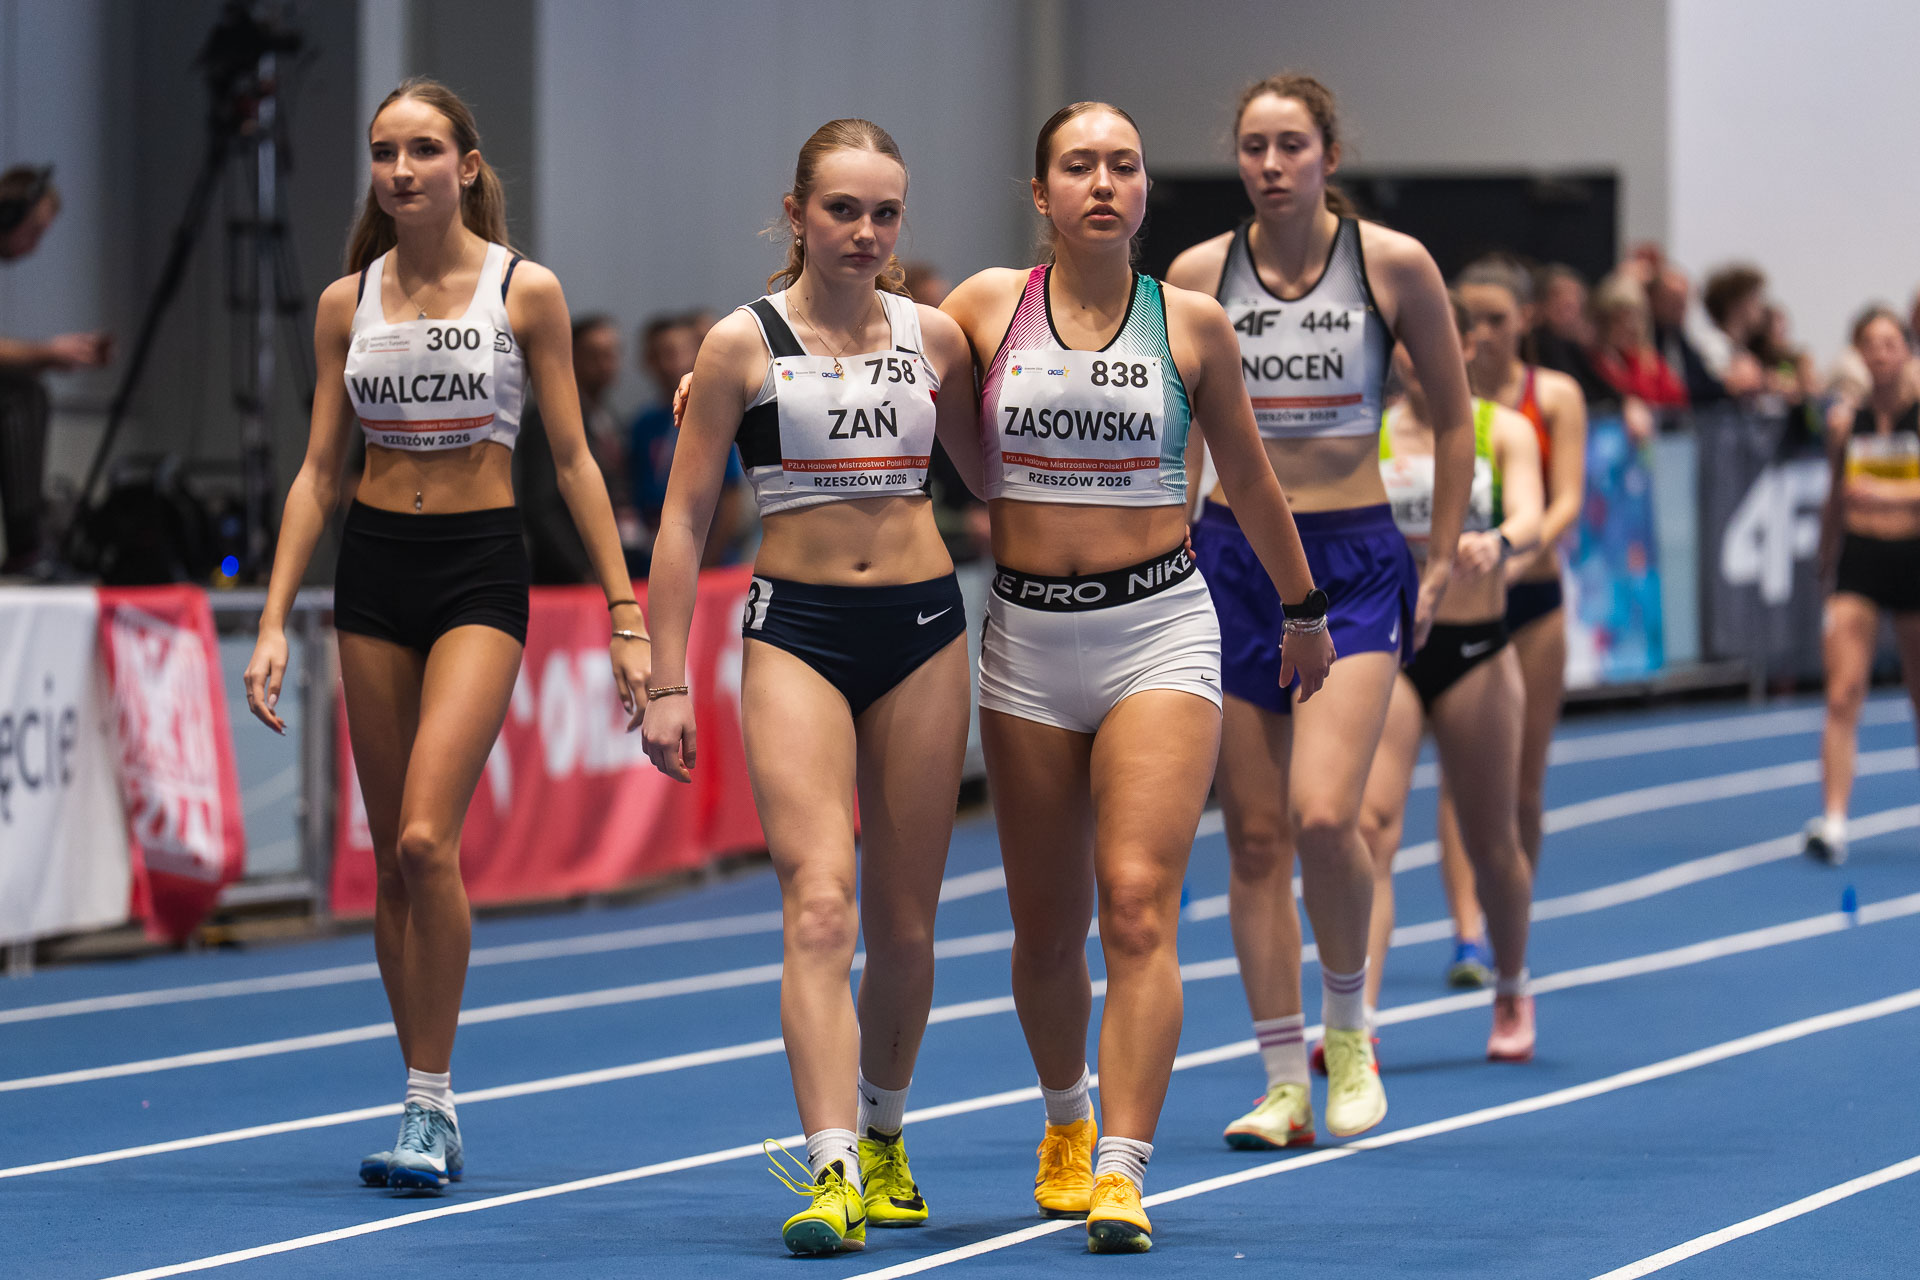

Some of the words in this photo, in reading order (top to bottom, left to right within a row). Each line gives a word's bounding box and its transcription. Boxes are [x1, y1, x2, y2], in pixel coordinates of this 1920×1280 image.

[1234, 309, 1281, 336] 4F
[1301, 311, 1350, 333] 444
[427, 328, 480, 351] 300
[865, 358, 916, 385] 758
[1090, 361, 1149, 388] 838
[351, 373, 488, 404] WALCZAK
[828, 401, 898, 439] ZAŃ
[1004, 407, 1156, 441] ZASOWSKA
[382, 434, 435, 446] RZESZÓW
[438, 433, 471, 445] 2026
[838, 461, 885, 469] Mistrzostwa
[886, 459, 902, 467] Polski
[1006, 454, 1023, 463] PZLA
[1024, 456, 1049, 467] Halowe
[1050, 460, 1098, 469] Mistrzostwa
[1100, 461, 1122, 470] Polski
[1123, 460, 1136, 469] U18
[1140, 459, 1155, 467] U20
[814, 472, 882, 487] RZESZÓW
[885, 474, 907, 485] 2026
[1028, 472, 1093, 487] RZESZÓW
[1097, 476, 1131, 487] 2026
[1019, 581, 1106, 605] PRO
[1127, 549, 1192, 596] NIKE
